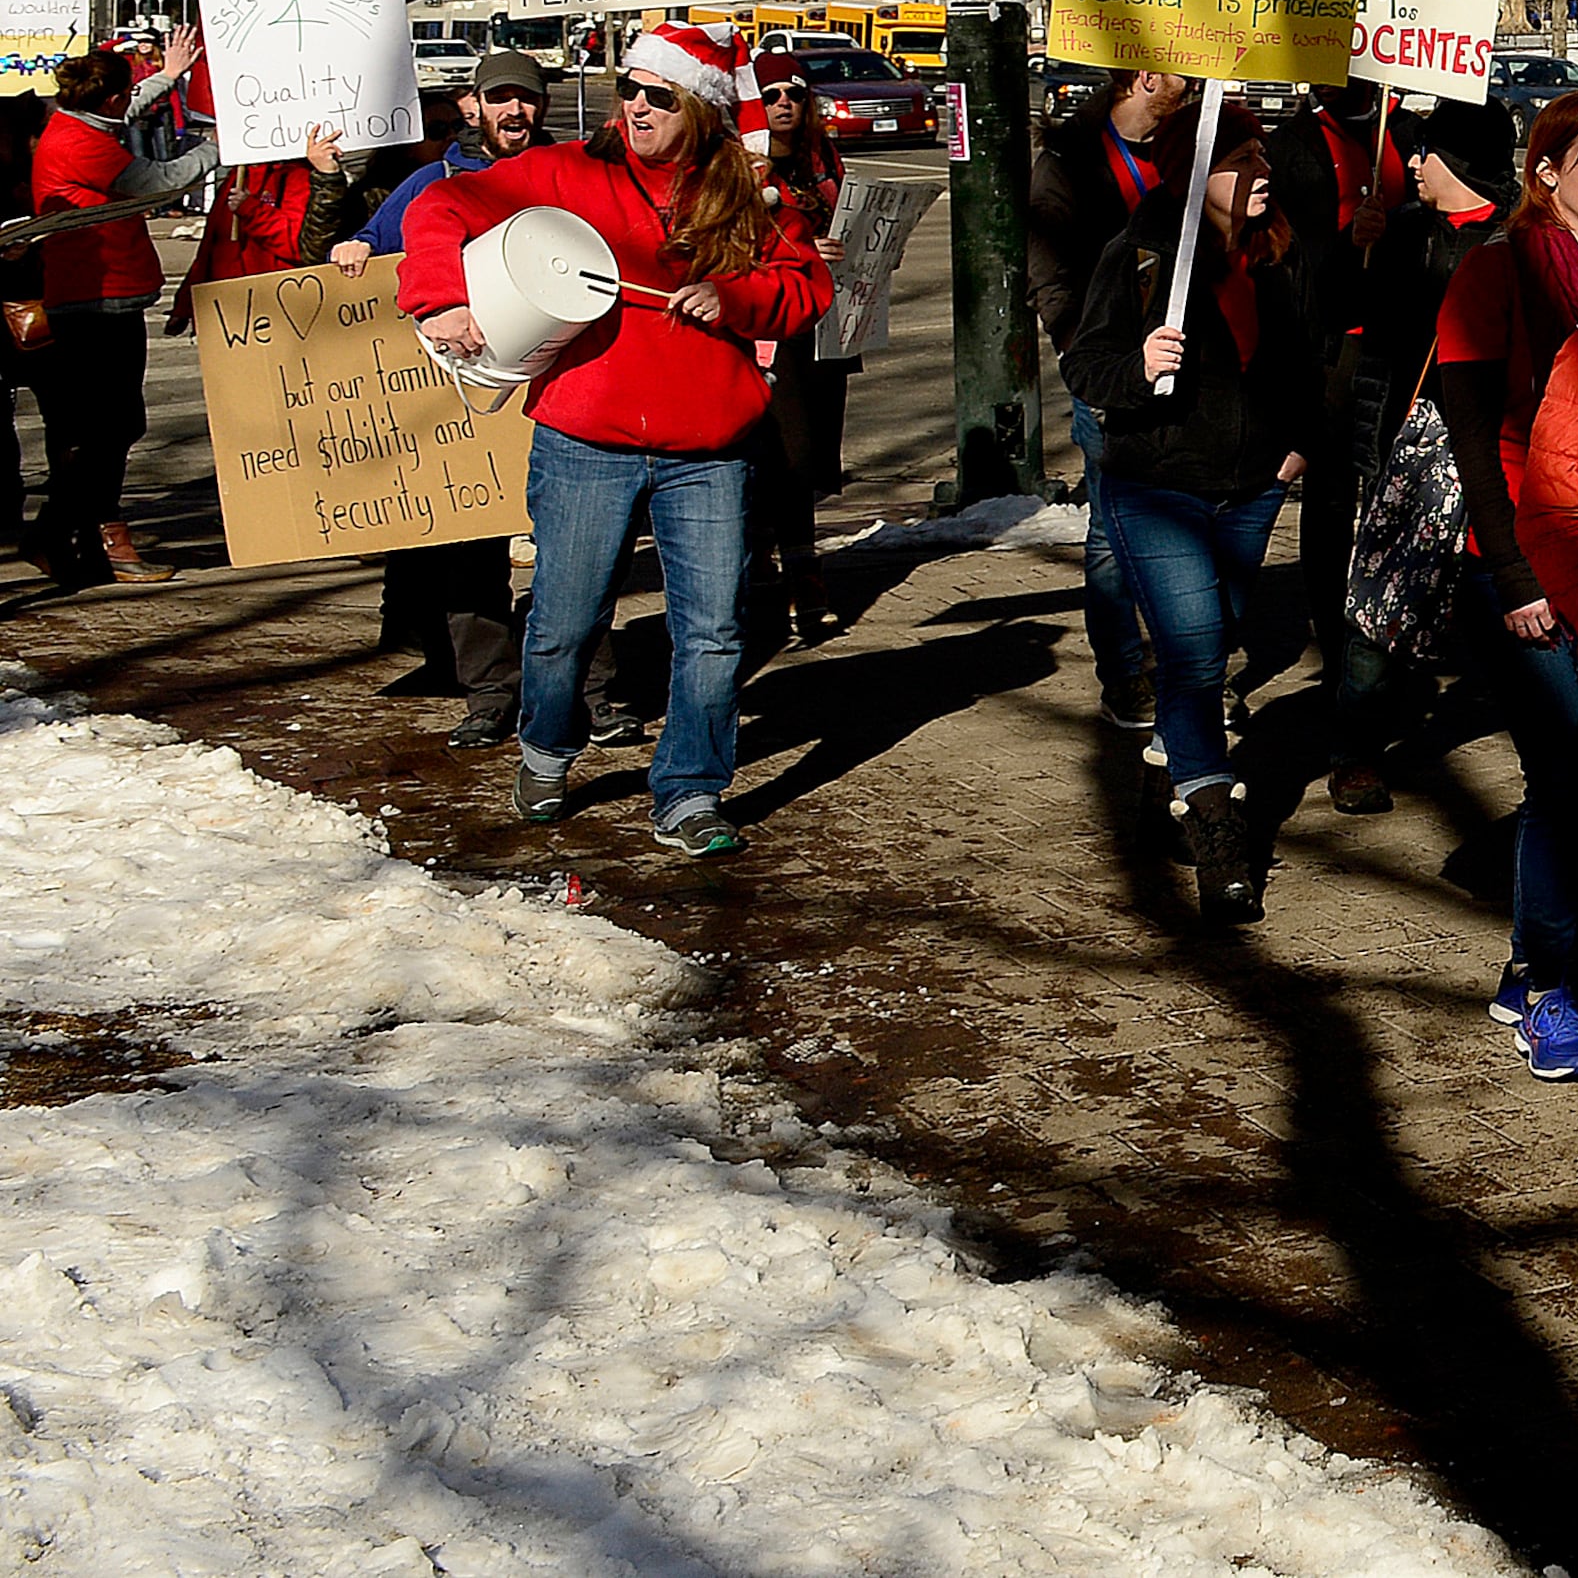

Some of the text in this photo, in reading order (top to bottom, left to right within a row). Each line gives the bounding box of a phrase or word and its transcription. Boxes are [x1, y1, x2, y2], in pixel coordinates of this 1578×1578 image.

[1056, 9, 1143, 35] Teachers
[1164, 14, 1246, 45] students
[1252, 29, 1281, 45] are
[1292, 29, 1346, 49] worth
[1058, 29, 1094, 53] the
[235, 64, 362, 108] Quality
[213, 288, 272, 349] We
[338, 297, 379, 327] our
[280, 358, 313, 409] but
[328, 376, 364, 403] our
[241, 419, 300, 481] need
[435, 407, 475, 446] and
[314, 451, 505, 544] $ecurity too!
